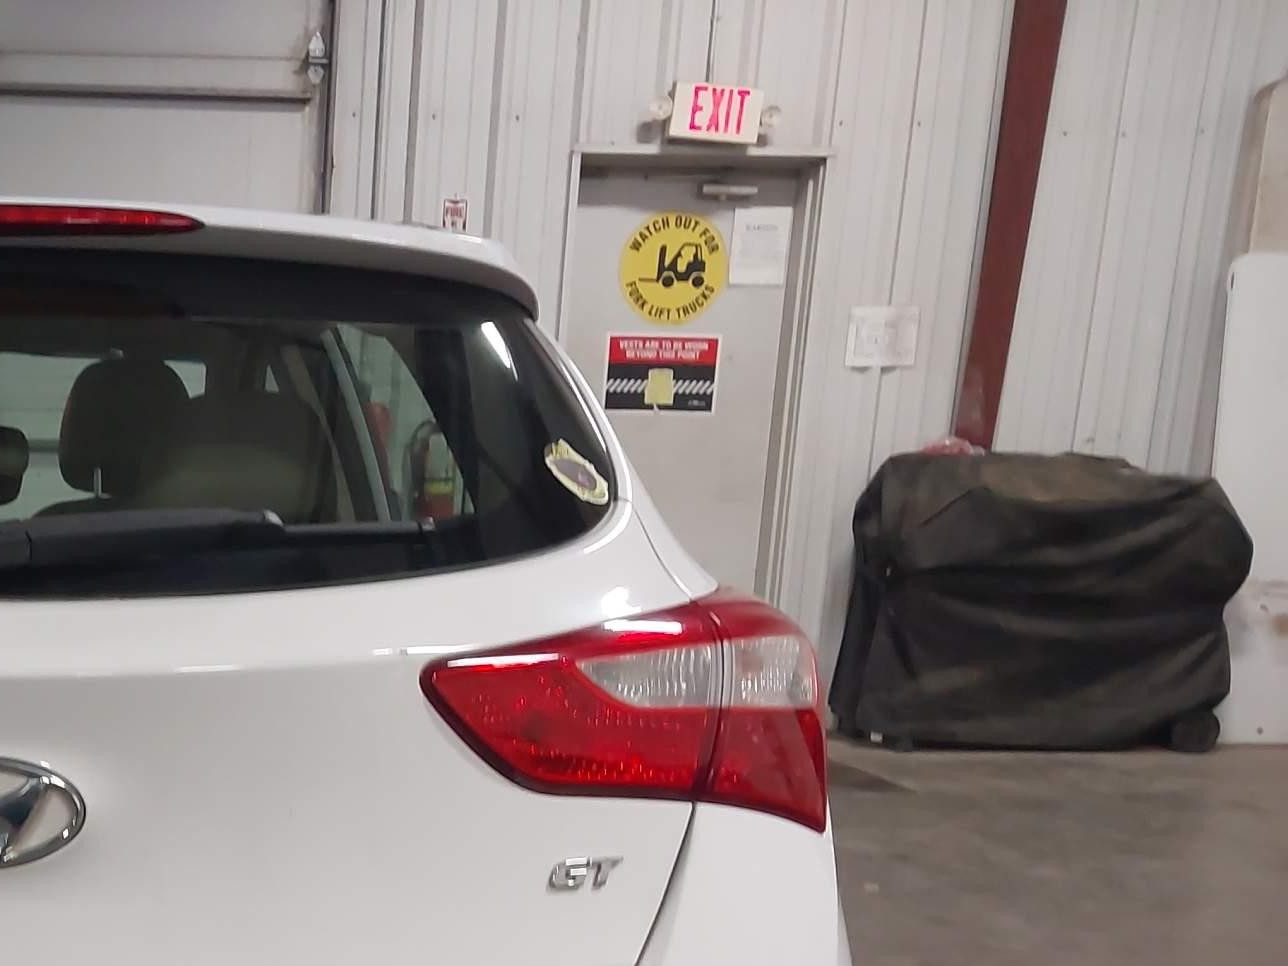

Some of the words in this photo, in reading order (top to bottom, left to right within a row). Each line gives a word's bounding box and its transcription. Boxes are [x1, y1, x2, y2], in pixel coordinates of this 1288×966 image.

[689, 86, 751, 135] EXIT
[629, 215, 670, 253] WATCH
[675, 215, 700, 233] OUT
[699, 228, 720, 255] FOR
[625, 280, 648, 311] FORK
[648, 304, 671, 321] LIFT
[675, 284, 715, 319] TRUCKS
[619, 339, 643, 350] VESTS
[644, 340, 659, 350] ARE
[662, 340, 672, 350] TO
[673, 341, 683, 350] BE
[625, 350, 657, 359] BEYOND
[659, 350, 675, 360] THIS
[677, 351, 701, 360] POINT
[547, 856, 624, 892] GT
